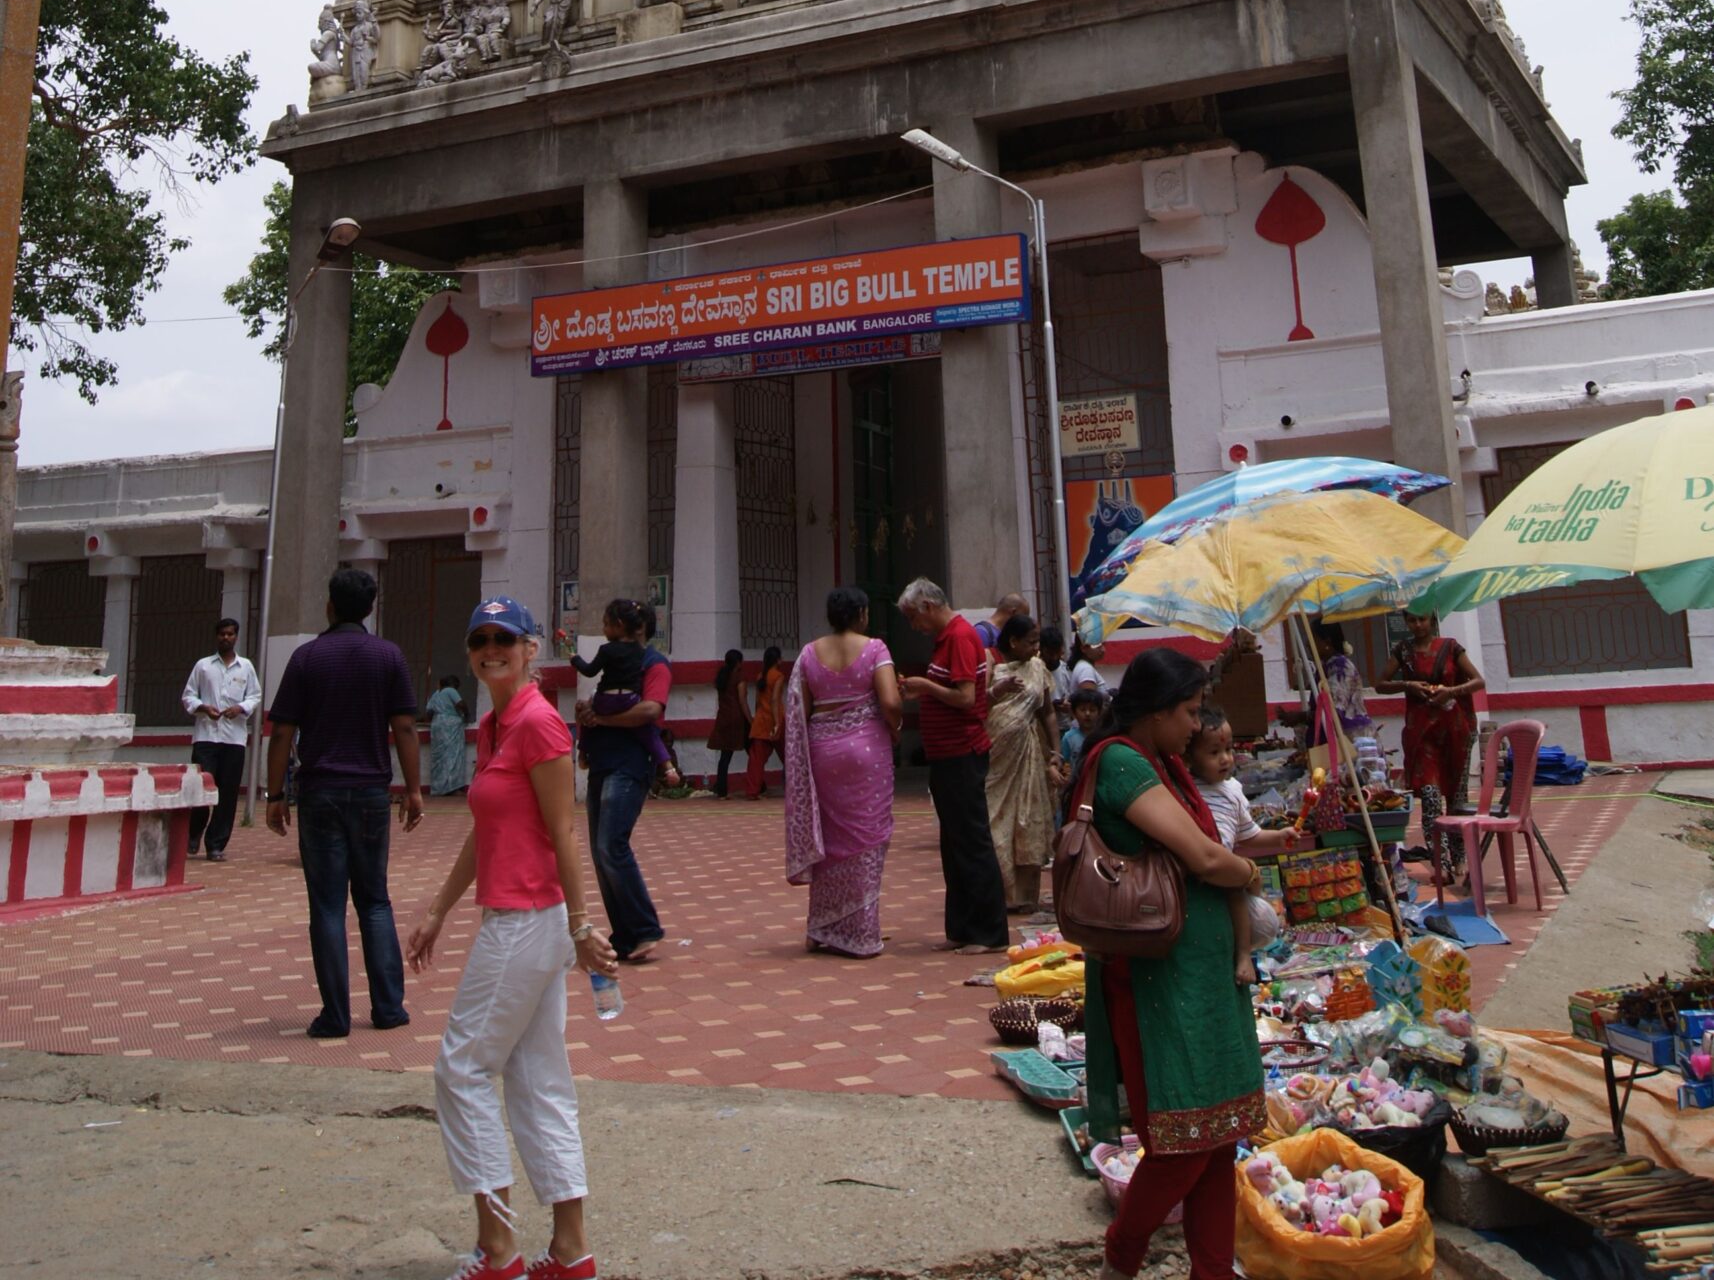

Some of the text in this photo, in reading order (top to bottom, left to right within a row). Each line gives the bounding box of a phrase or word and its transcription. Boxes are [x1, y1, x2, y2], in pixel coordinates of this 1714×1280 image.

[533, 257, 1020, 351] ಶ್ರೀ ದೊಡ್ಡ ಬಸವಣ್ಣ ದೇವಸ್ಥಾನ SRI BIG BULL TEMPLE
[714, 332, 749, 347] SREE
[753, 325, 812, 343] CHARAN
[816, 320, 857, 336] BANK
[863, 312, 932, 330] BANGALORE
[756, 348, 811, 366] BULL
[816, 338, 906, 359] TEMPLE
[1563, 479, 1631, 512] India
[1504, 514, 1600, 544] ka tadka
